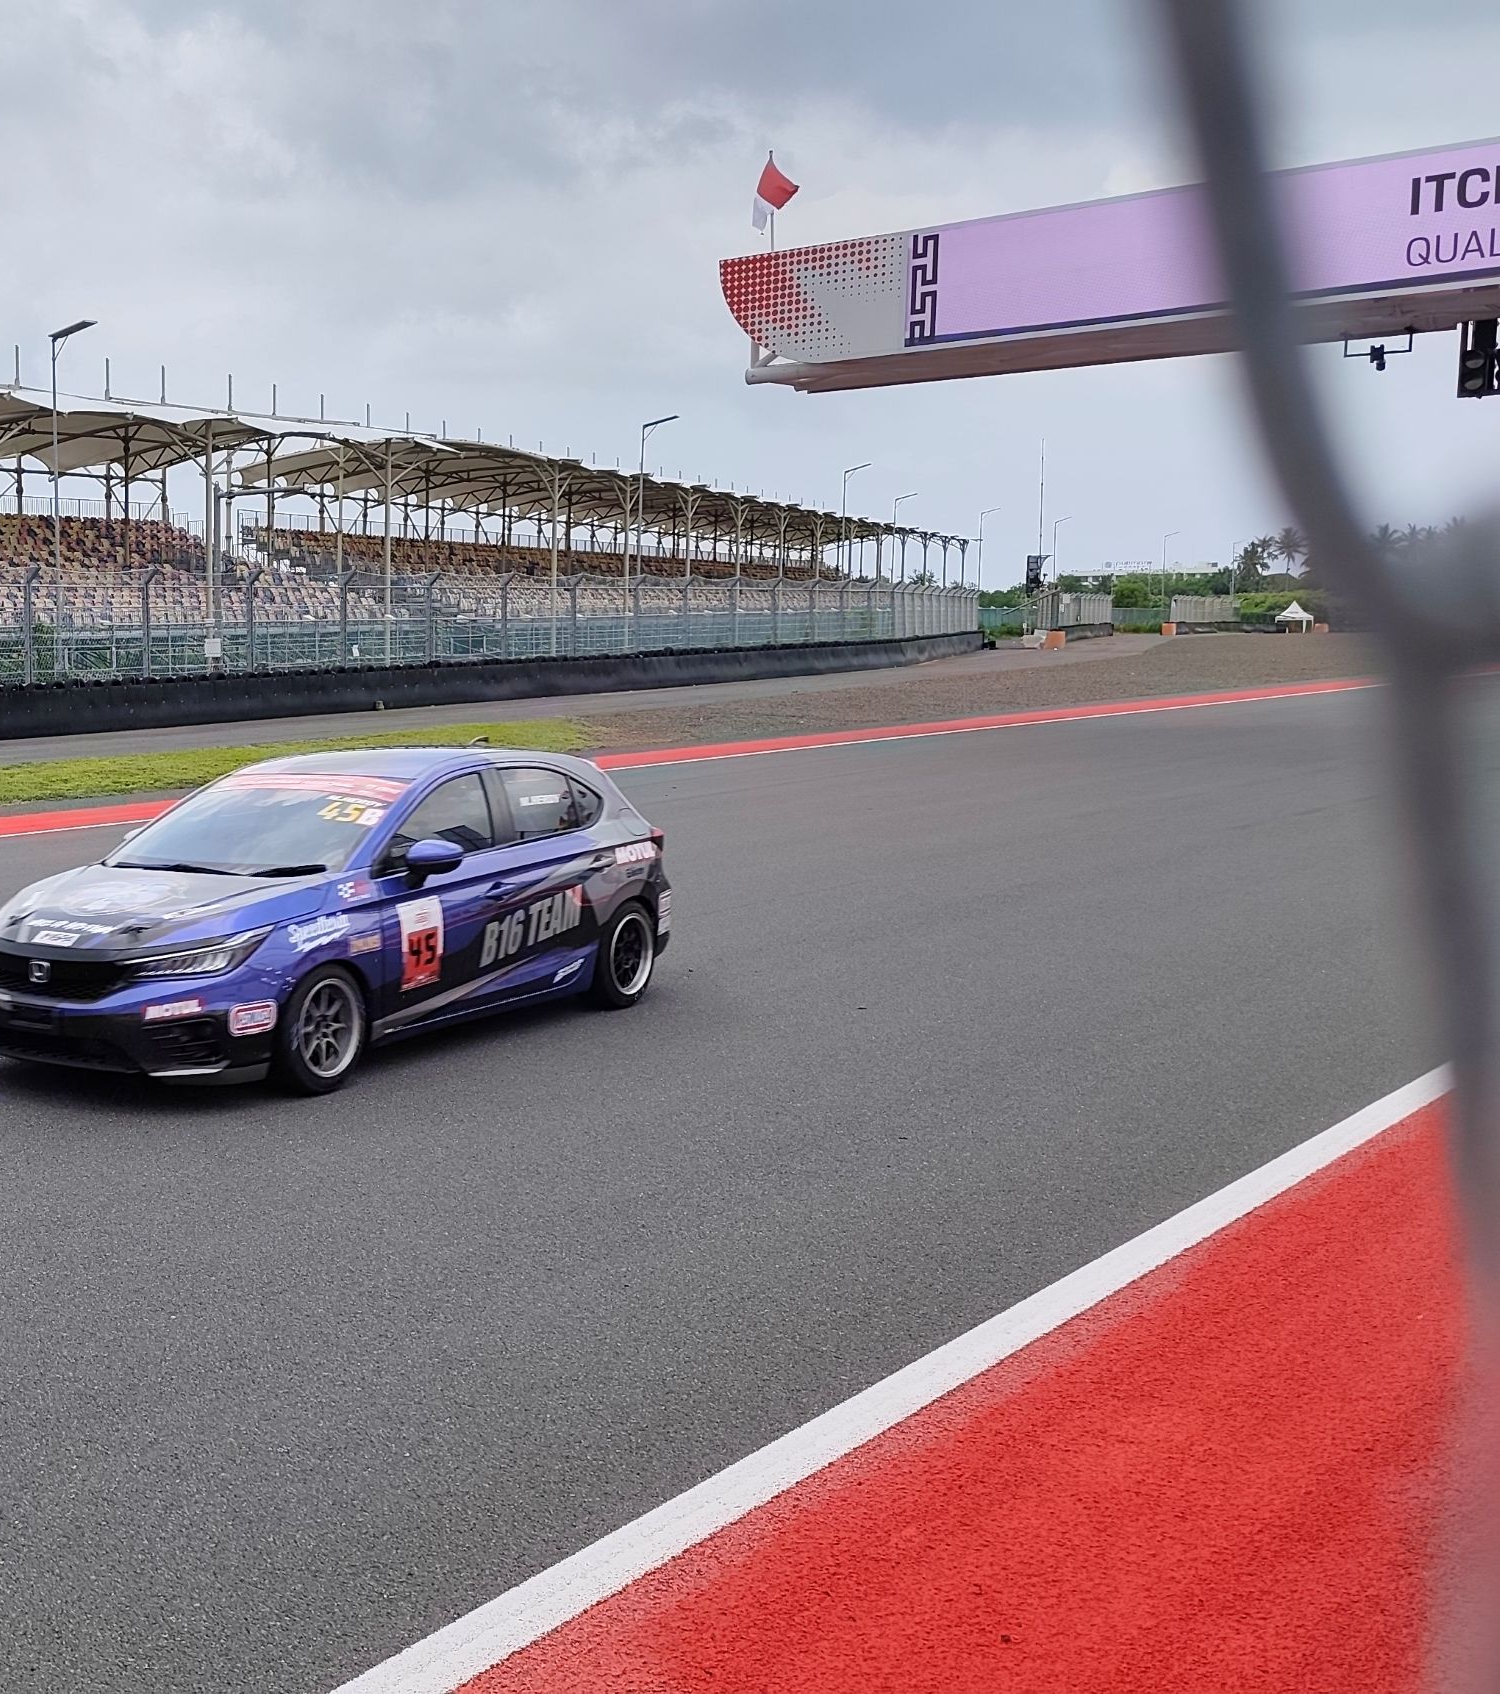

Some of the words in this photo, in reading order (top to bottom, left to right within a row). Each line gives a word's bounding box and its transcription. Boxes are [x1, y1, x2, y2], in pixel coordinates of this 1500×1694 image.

[1410, 166, 1500, 215] ITC
[1406, 228, 1500, 267] QUAL
[615, 841, 655, 865] MOTUL
[527, 884, 582, 947] TEAM
[408, 931, 438, 968] 45
